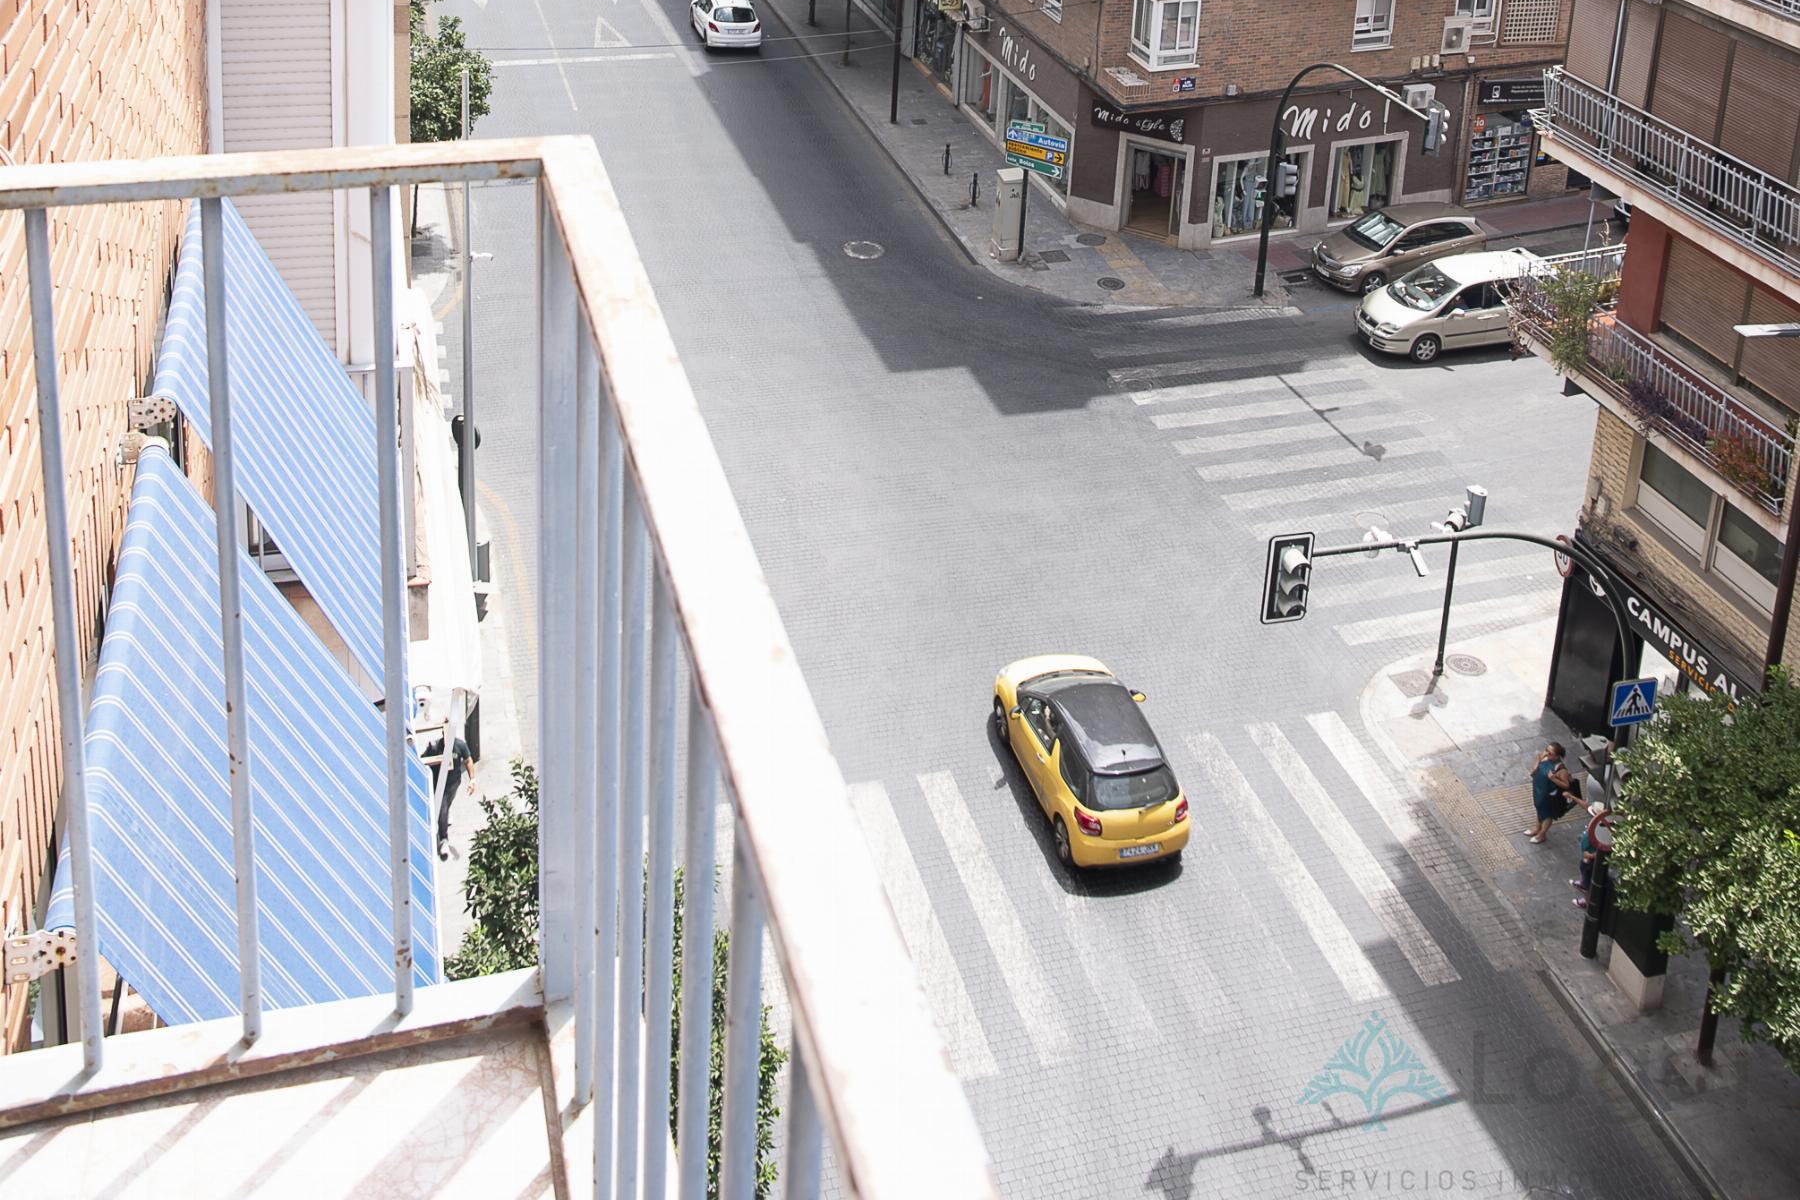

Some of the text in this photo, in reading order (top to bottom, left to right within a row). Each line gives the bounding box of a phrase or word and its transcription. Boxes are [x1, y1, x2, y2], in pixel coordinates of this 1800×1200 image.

[999, 26, 1035, 81] Mido
[1094, 107, 1166, 132] Mido style
[1282, 102, 1372, 140] Mido
[1626, 596, 1709, 676] CAMPUS
